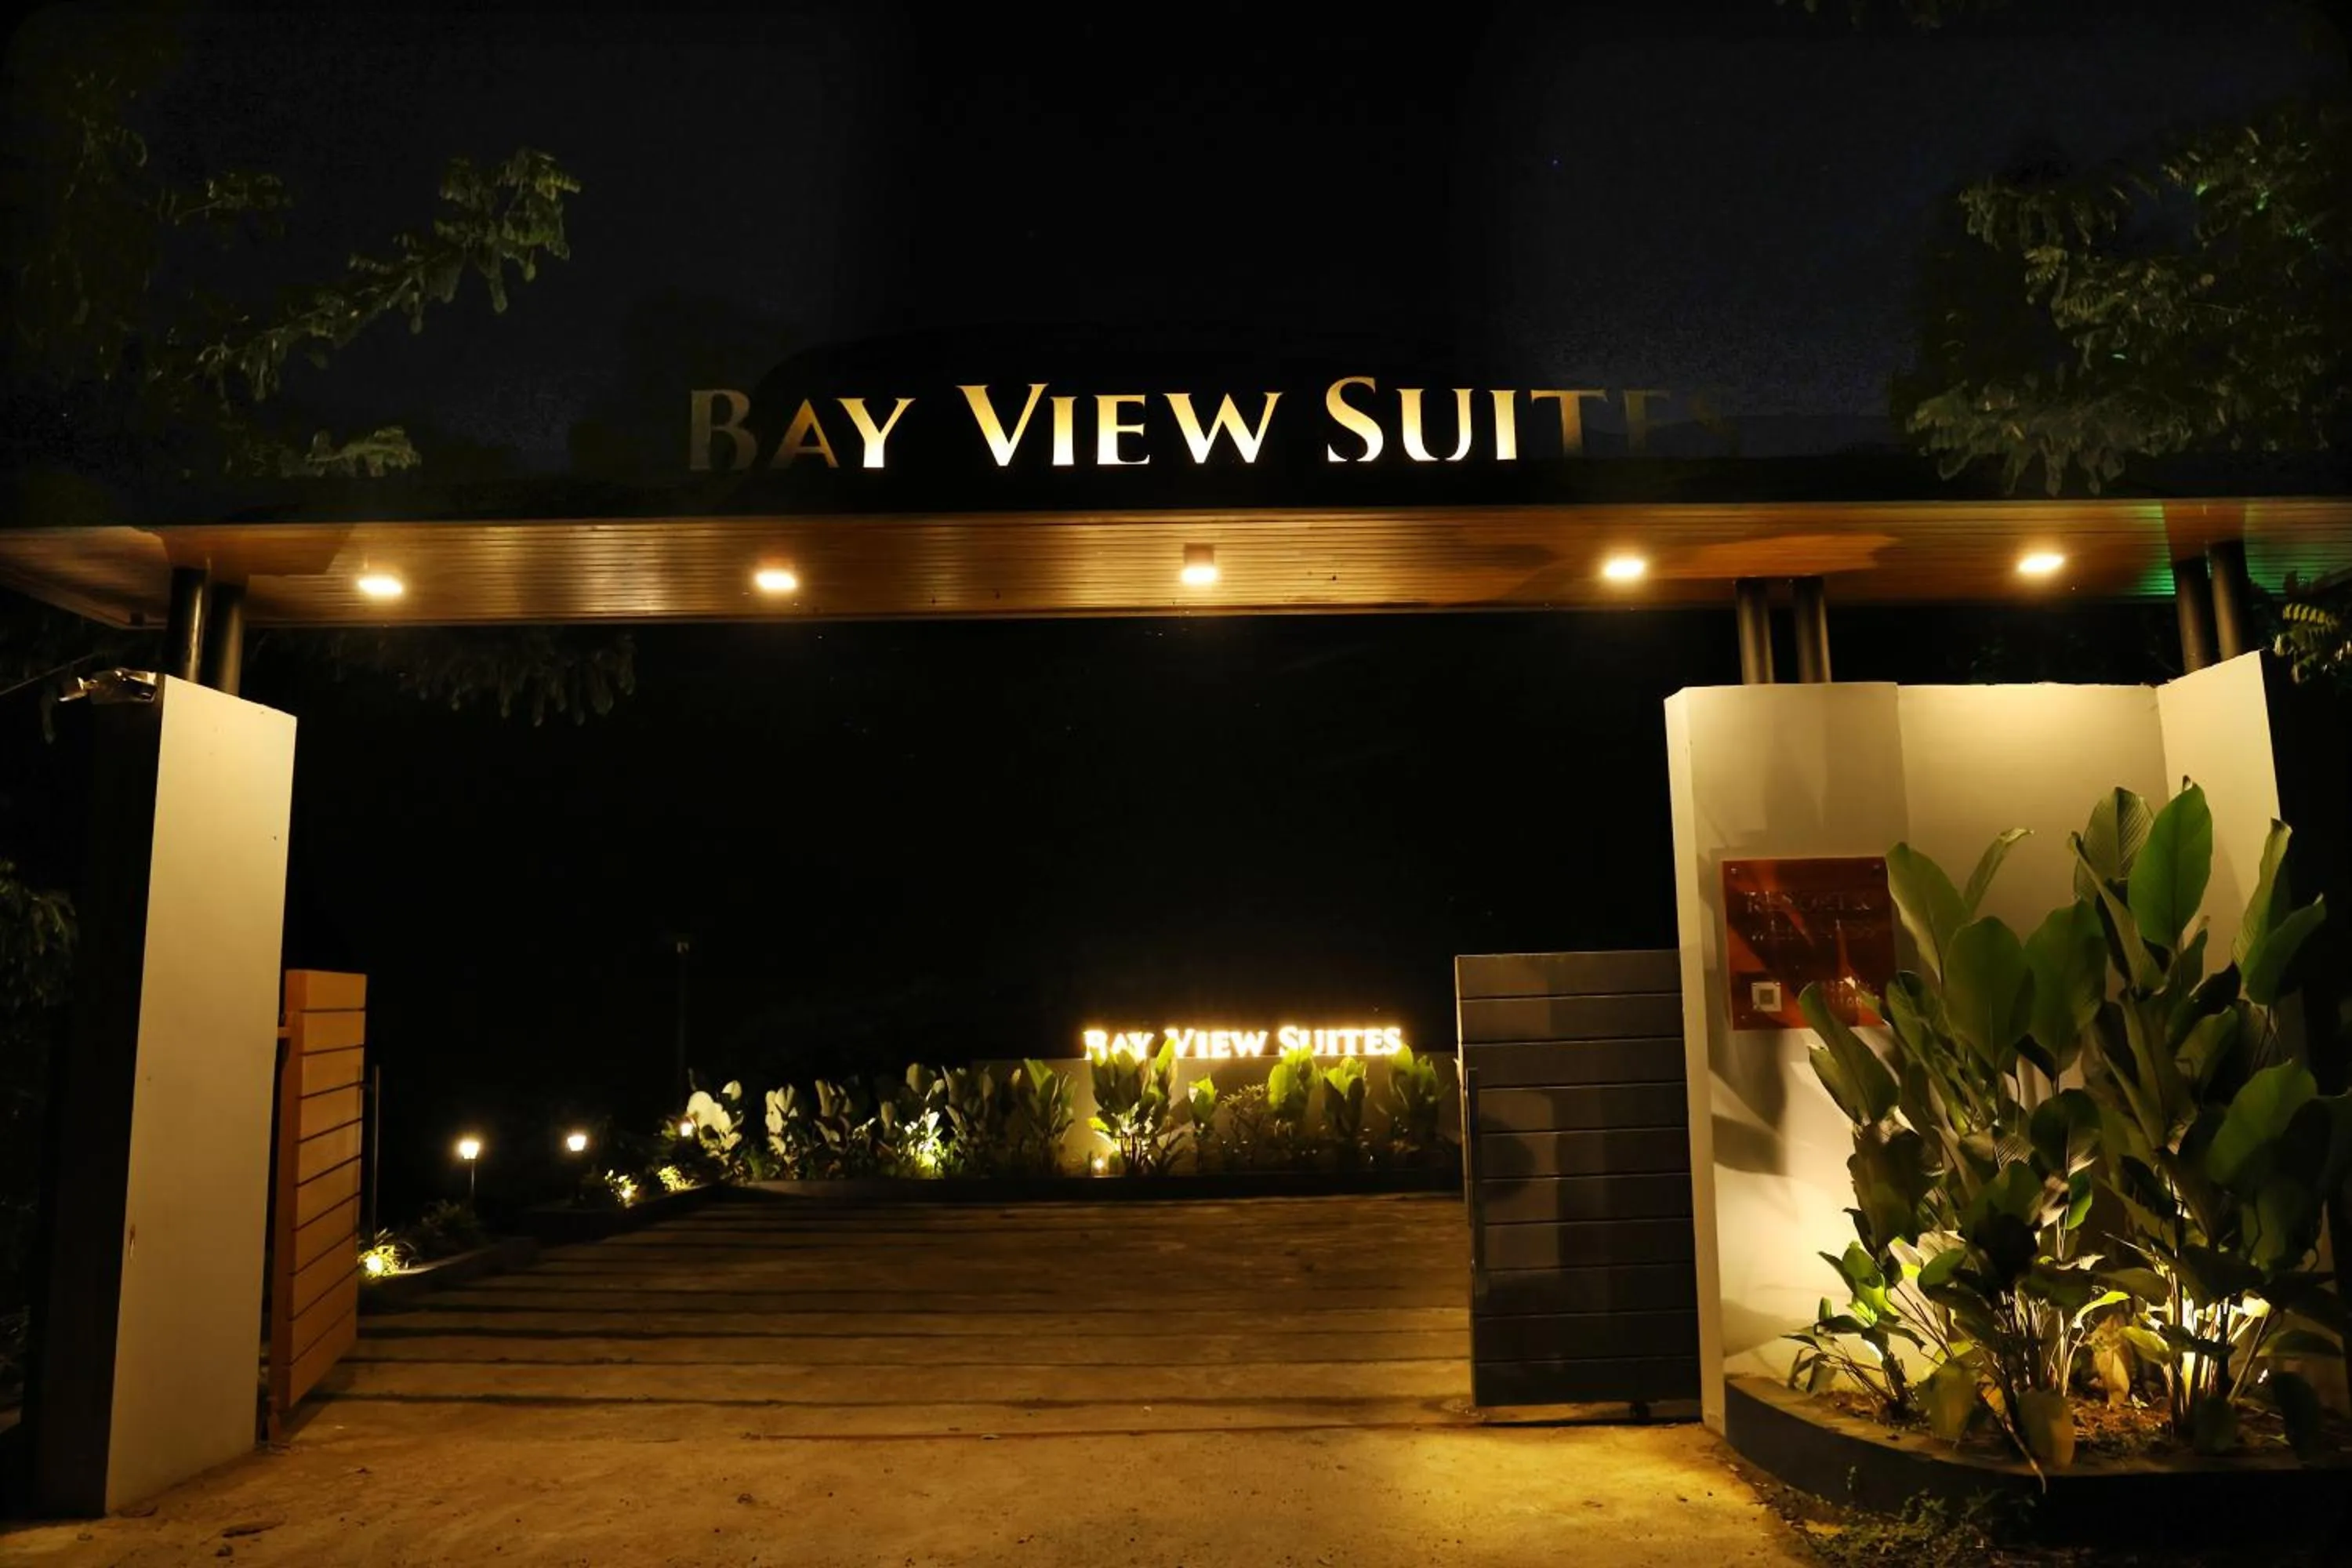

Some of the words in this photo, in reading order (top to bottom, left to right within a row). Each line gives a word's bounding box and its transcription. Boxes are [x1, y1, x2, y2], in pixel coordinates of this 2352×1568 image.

[690, 388, 916, 470] BAY
[955, 383, 1283, 466] VIEW
[1163, 1027, 1269, 1059] VIEW
[1279, 1025, 1402, 1057] SUITES
